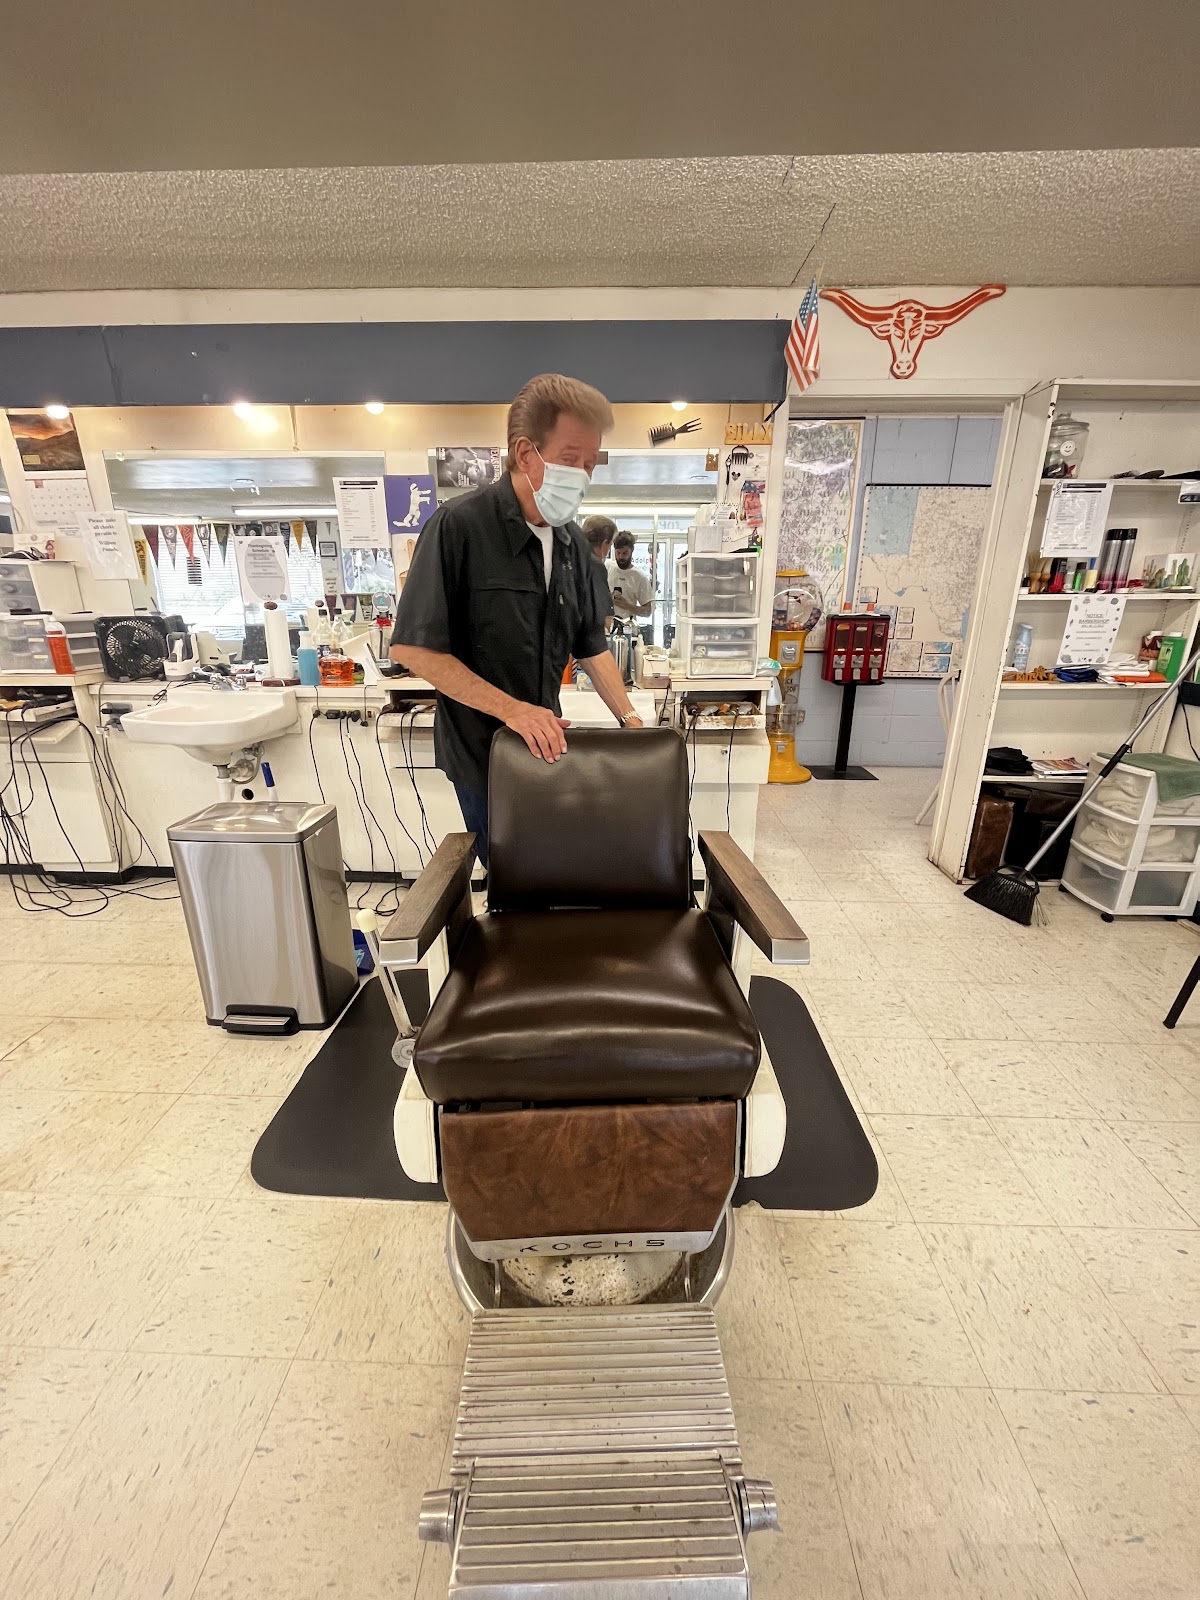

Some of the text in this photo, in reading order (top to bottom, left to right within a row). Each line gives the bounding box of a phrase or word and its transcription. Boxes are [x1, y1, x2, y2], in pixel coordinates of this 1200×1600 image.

[725, 423, 774, 442] BILLY
[490, 447, 500, 465] TEXAS
[519, 1239, 665, 1252] KOCHS
